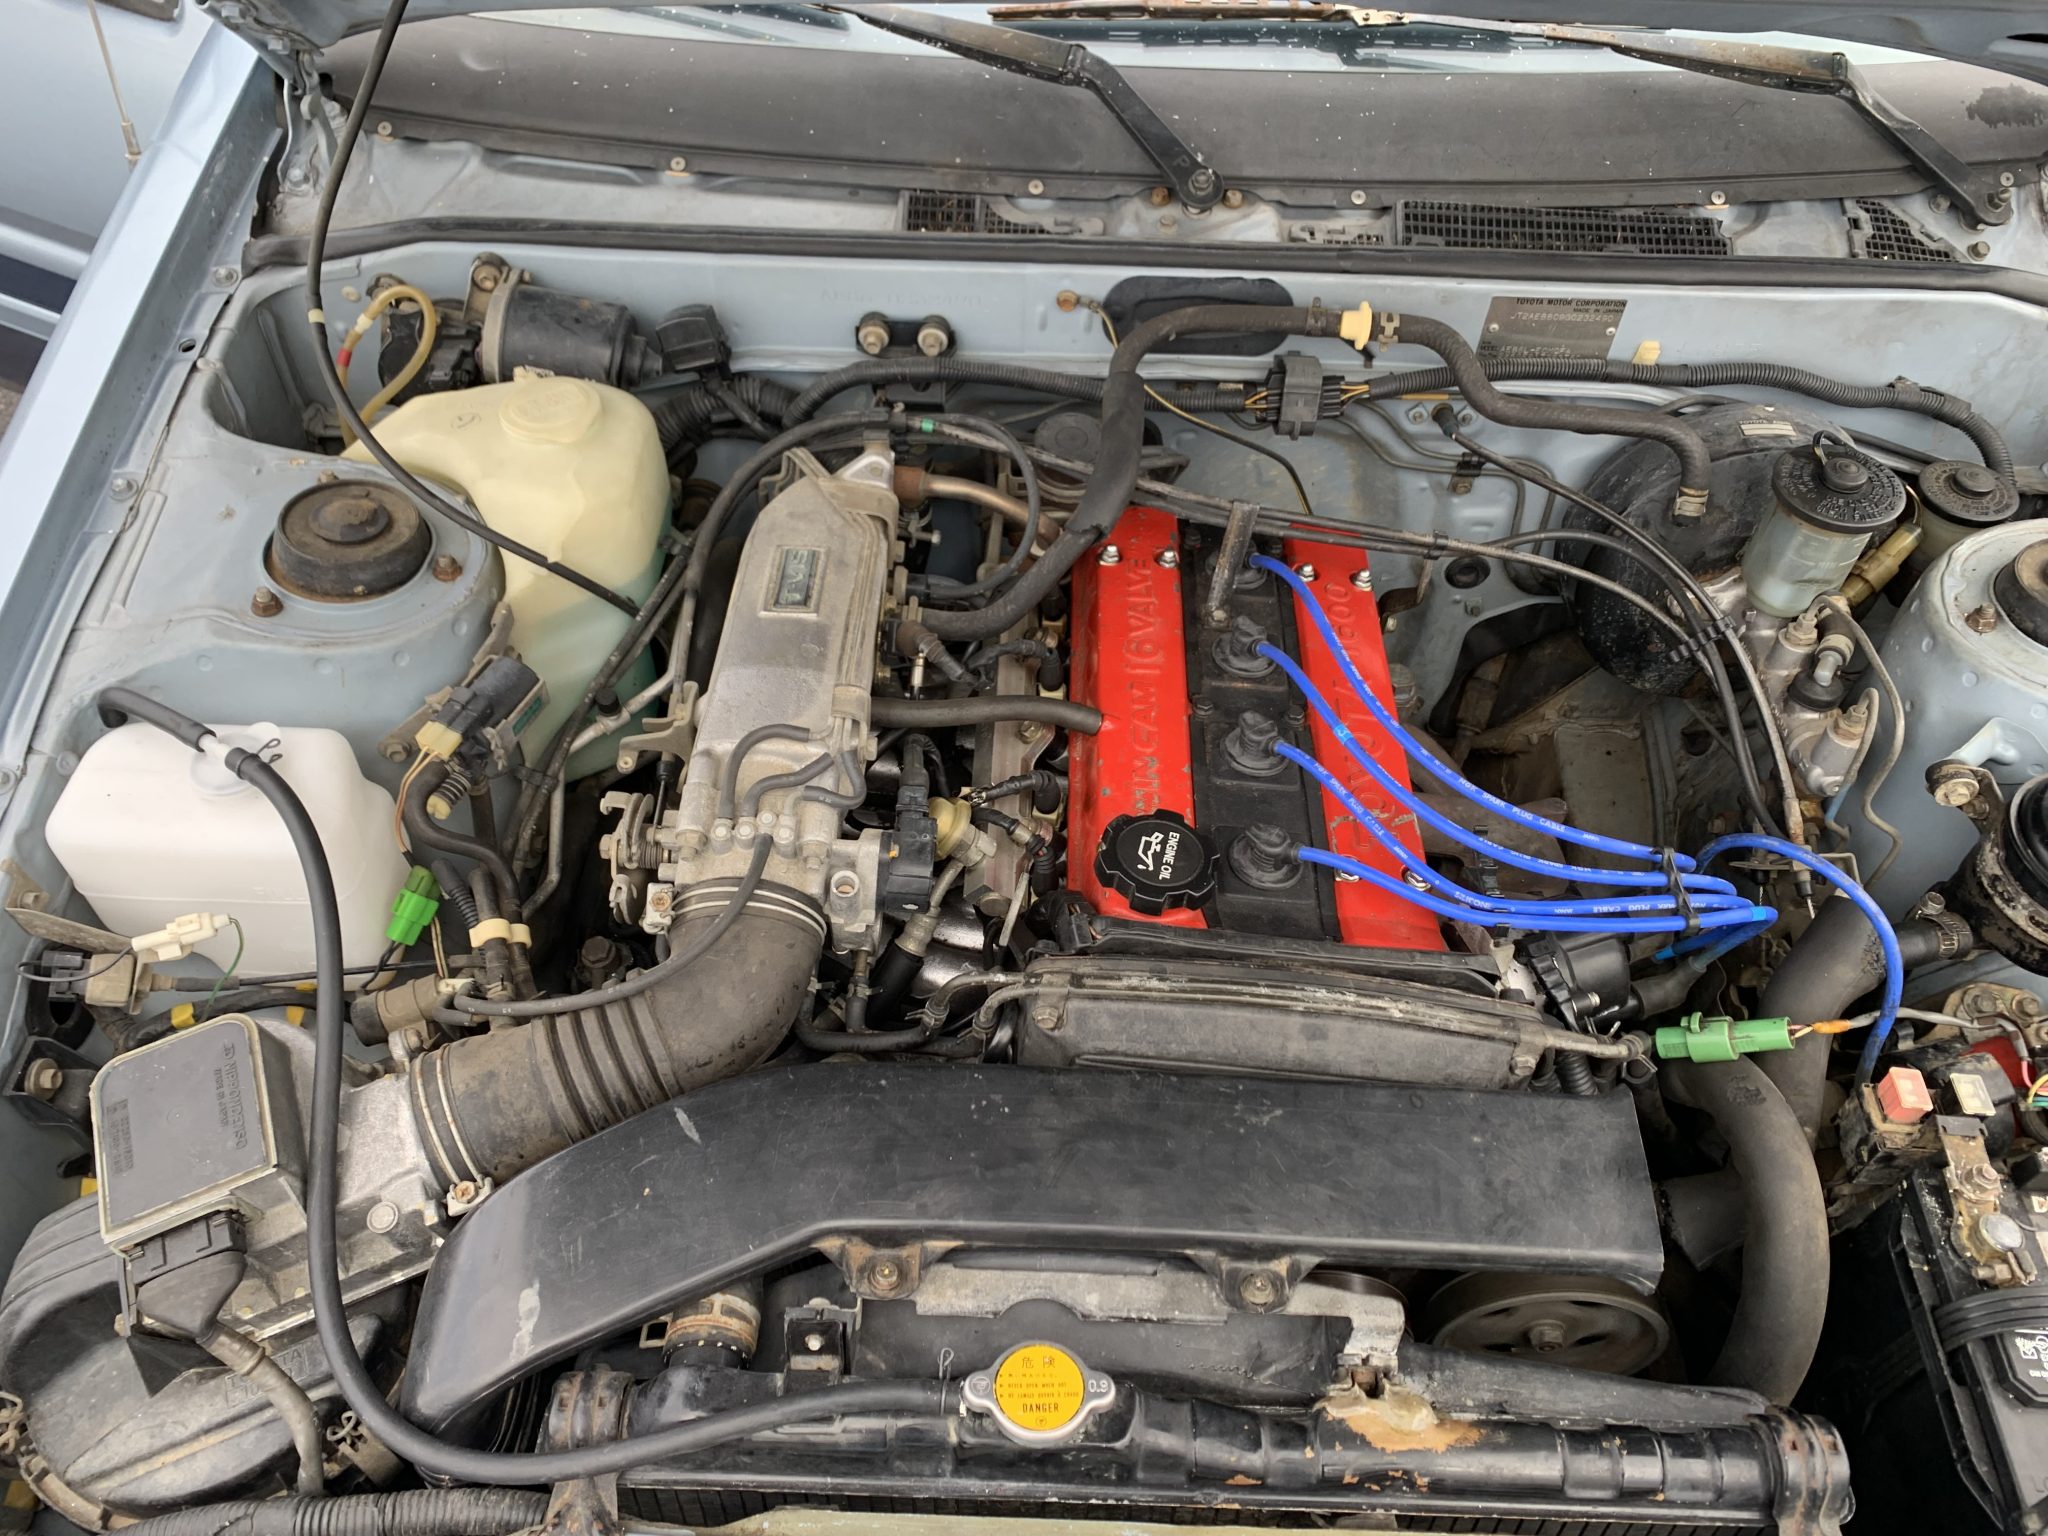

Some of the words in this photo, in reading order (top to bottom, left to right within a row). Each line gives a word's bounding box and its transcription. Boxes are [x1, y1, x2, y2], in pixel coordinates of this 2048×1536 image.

[1547, 298, 1573, 306] MOTOR
[1575, 299, 1627, 307] CORPORATION
[1458, 777, 1479, 793] NGK
[1481, 792, 1508, 809] SPARK
[1511, 806, 1534, 821] PLUG
[1539, 818, 1566, 833] CABLE
[1162, 831, 1181, 865] ENGINE
[1158, 865, 1175, 880] OIL
[1592, 904, 1621, 914] CABLE
[1087, 1379, 1109, 1393] 0.9
[1022, 1402, 1059, 1414] DANGER
